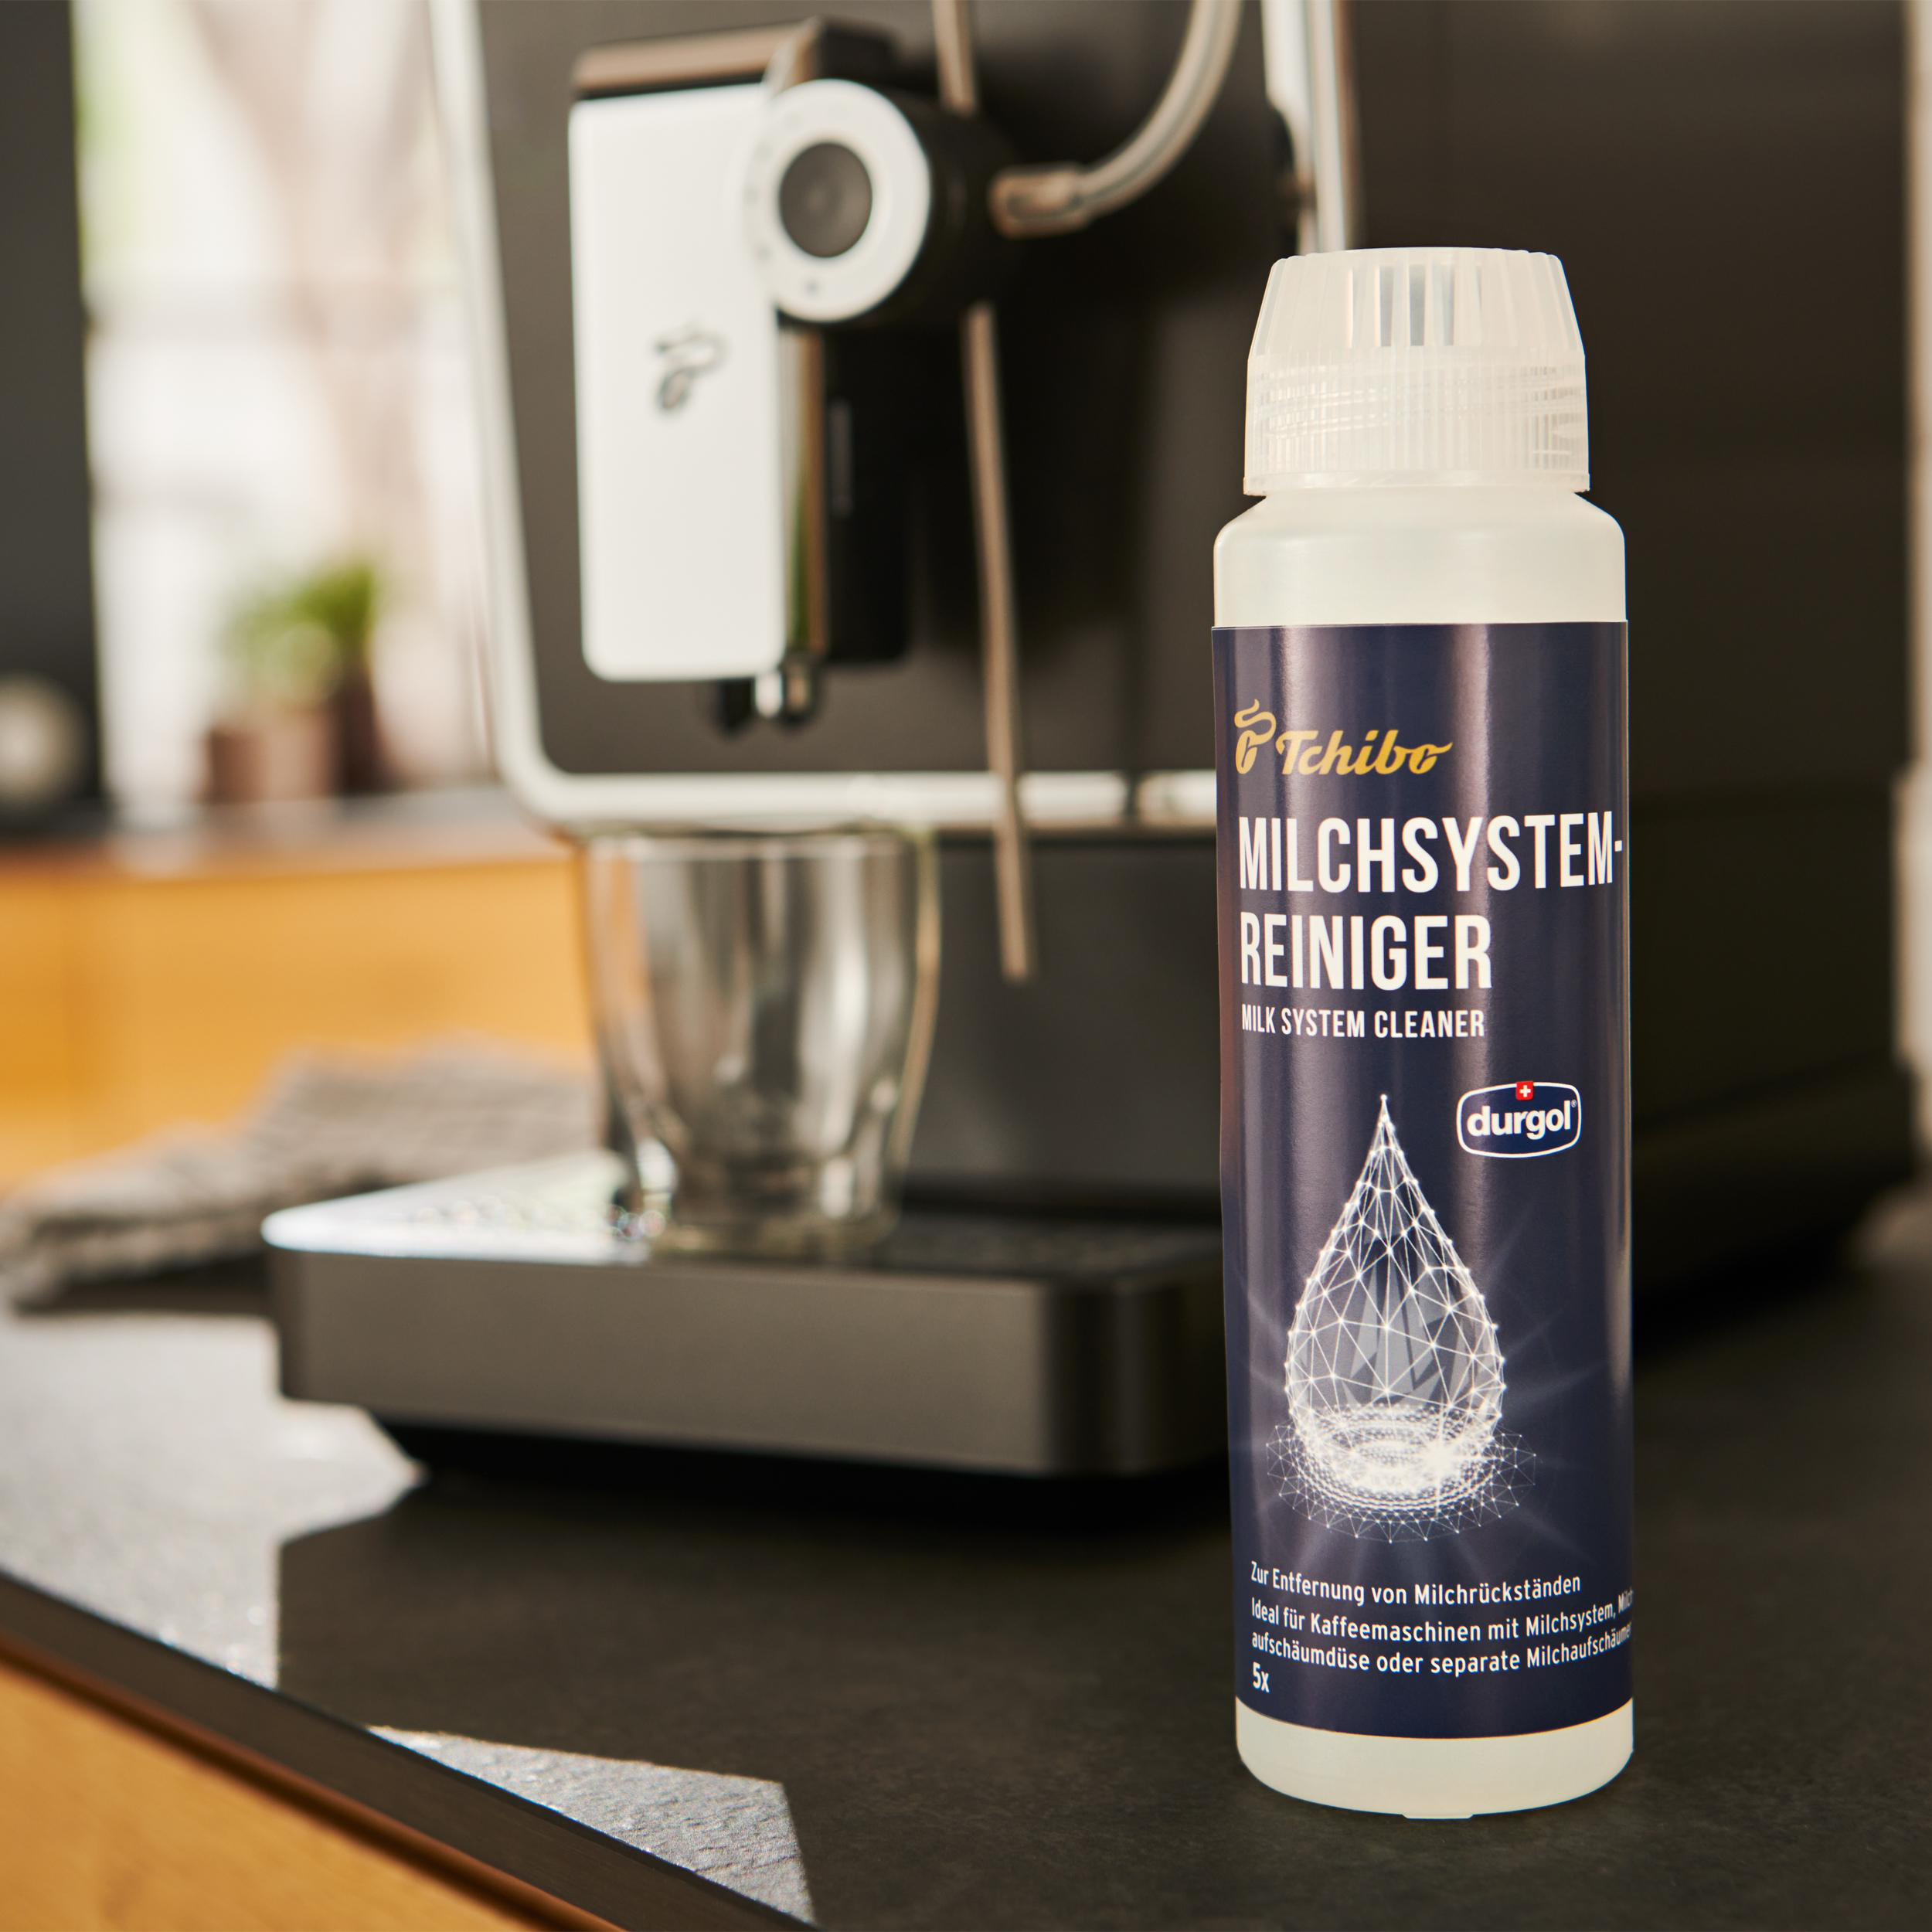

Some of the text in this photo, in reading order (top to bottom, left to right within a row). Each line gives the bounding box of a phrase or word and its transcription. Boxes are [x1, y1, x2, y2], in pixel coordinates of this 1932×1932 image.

[1276, 729, 1452, 774] Tchibo
[1239, 811, 1622, 893] MILCHSYSTEM-
[1240, 911, 1492, 990] REINIGER
[1242, 1004, 1485, 1038] MILK SYSTEM CLEANER
[1250, 1561, 1580, 1605] Zur Entfernung von Milchrückständen
[1251, 1597, 1279, 1625] Ideal
[1283, 1608, 1304, 1631] für
[1311, 1613, 1480, 1643] Kaffeemaschinen
[1488, 1620, 1519, 1641] mit
[1526, 1603, 1616, 1638] Milchsystem,
[1251, 1630, 1369, 1672] aufschäumdüse
[1376, 1652, 1423, 1673] oder
[1430, 1651, 1520, 1678] separate
[1252, 1662, 1270, 1693] 5x
